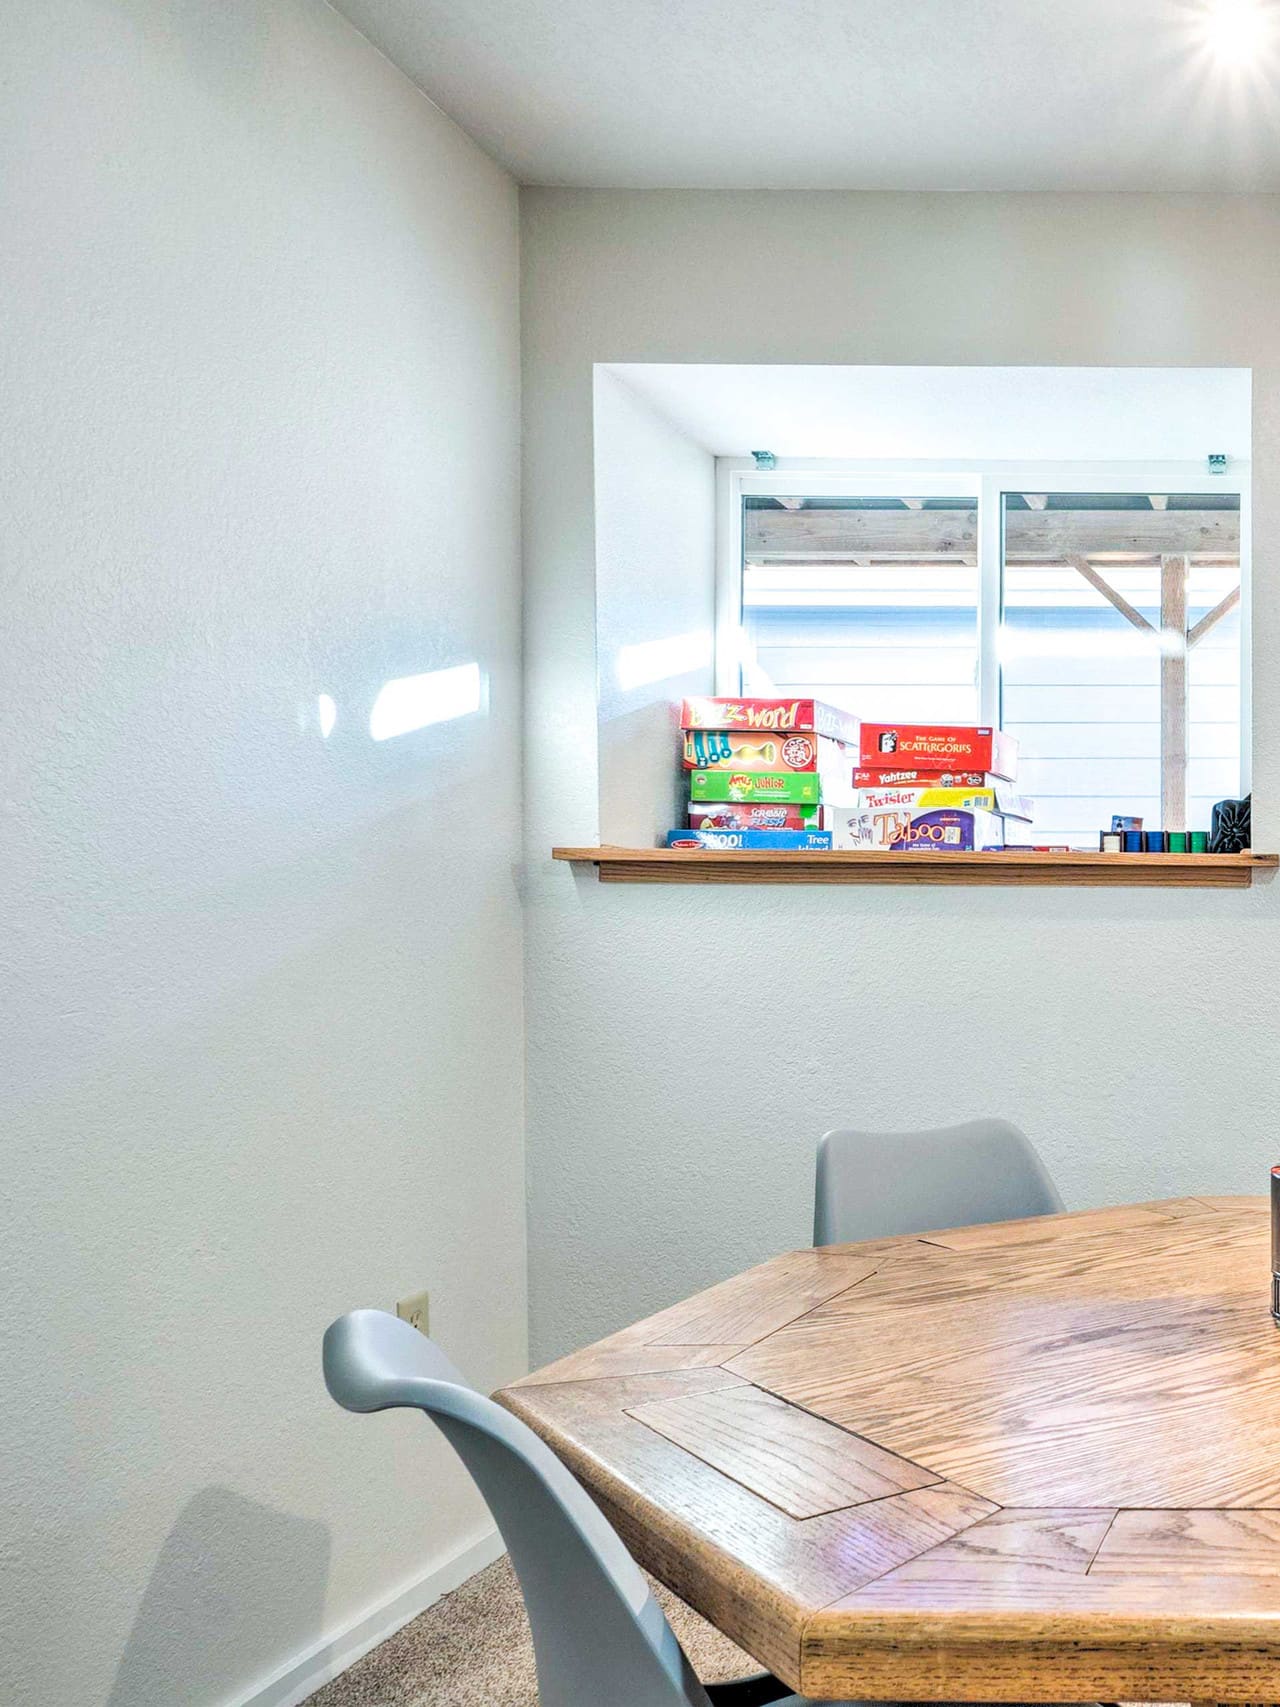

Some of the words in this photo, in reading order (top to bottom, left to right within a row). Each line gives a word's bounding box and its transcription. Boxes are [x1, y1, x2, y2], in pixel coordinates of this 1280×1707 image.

[878, 770, 918, 785] Yahtzee
[866, 790, 915, 808] Twister
[873, 811, 946, 846] Taboo
[807, 834, 829, 845] Tree
